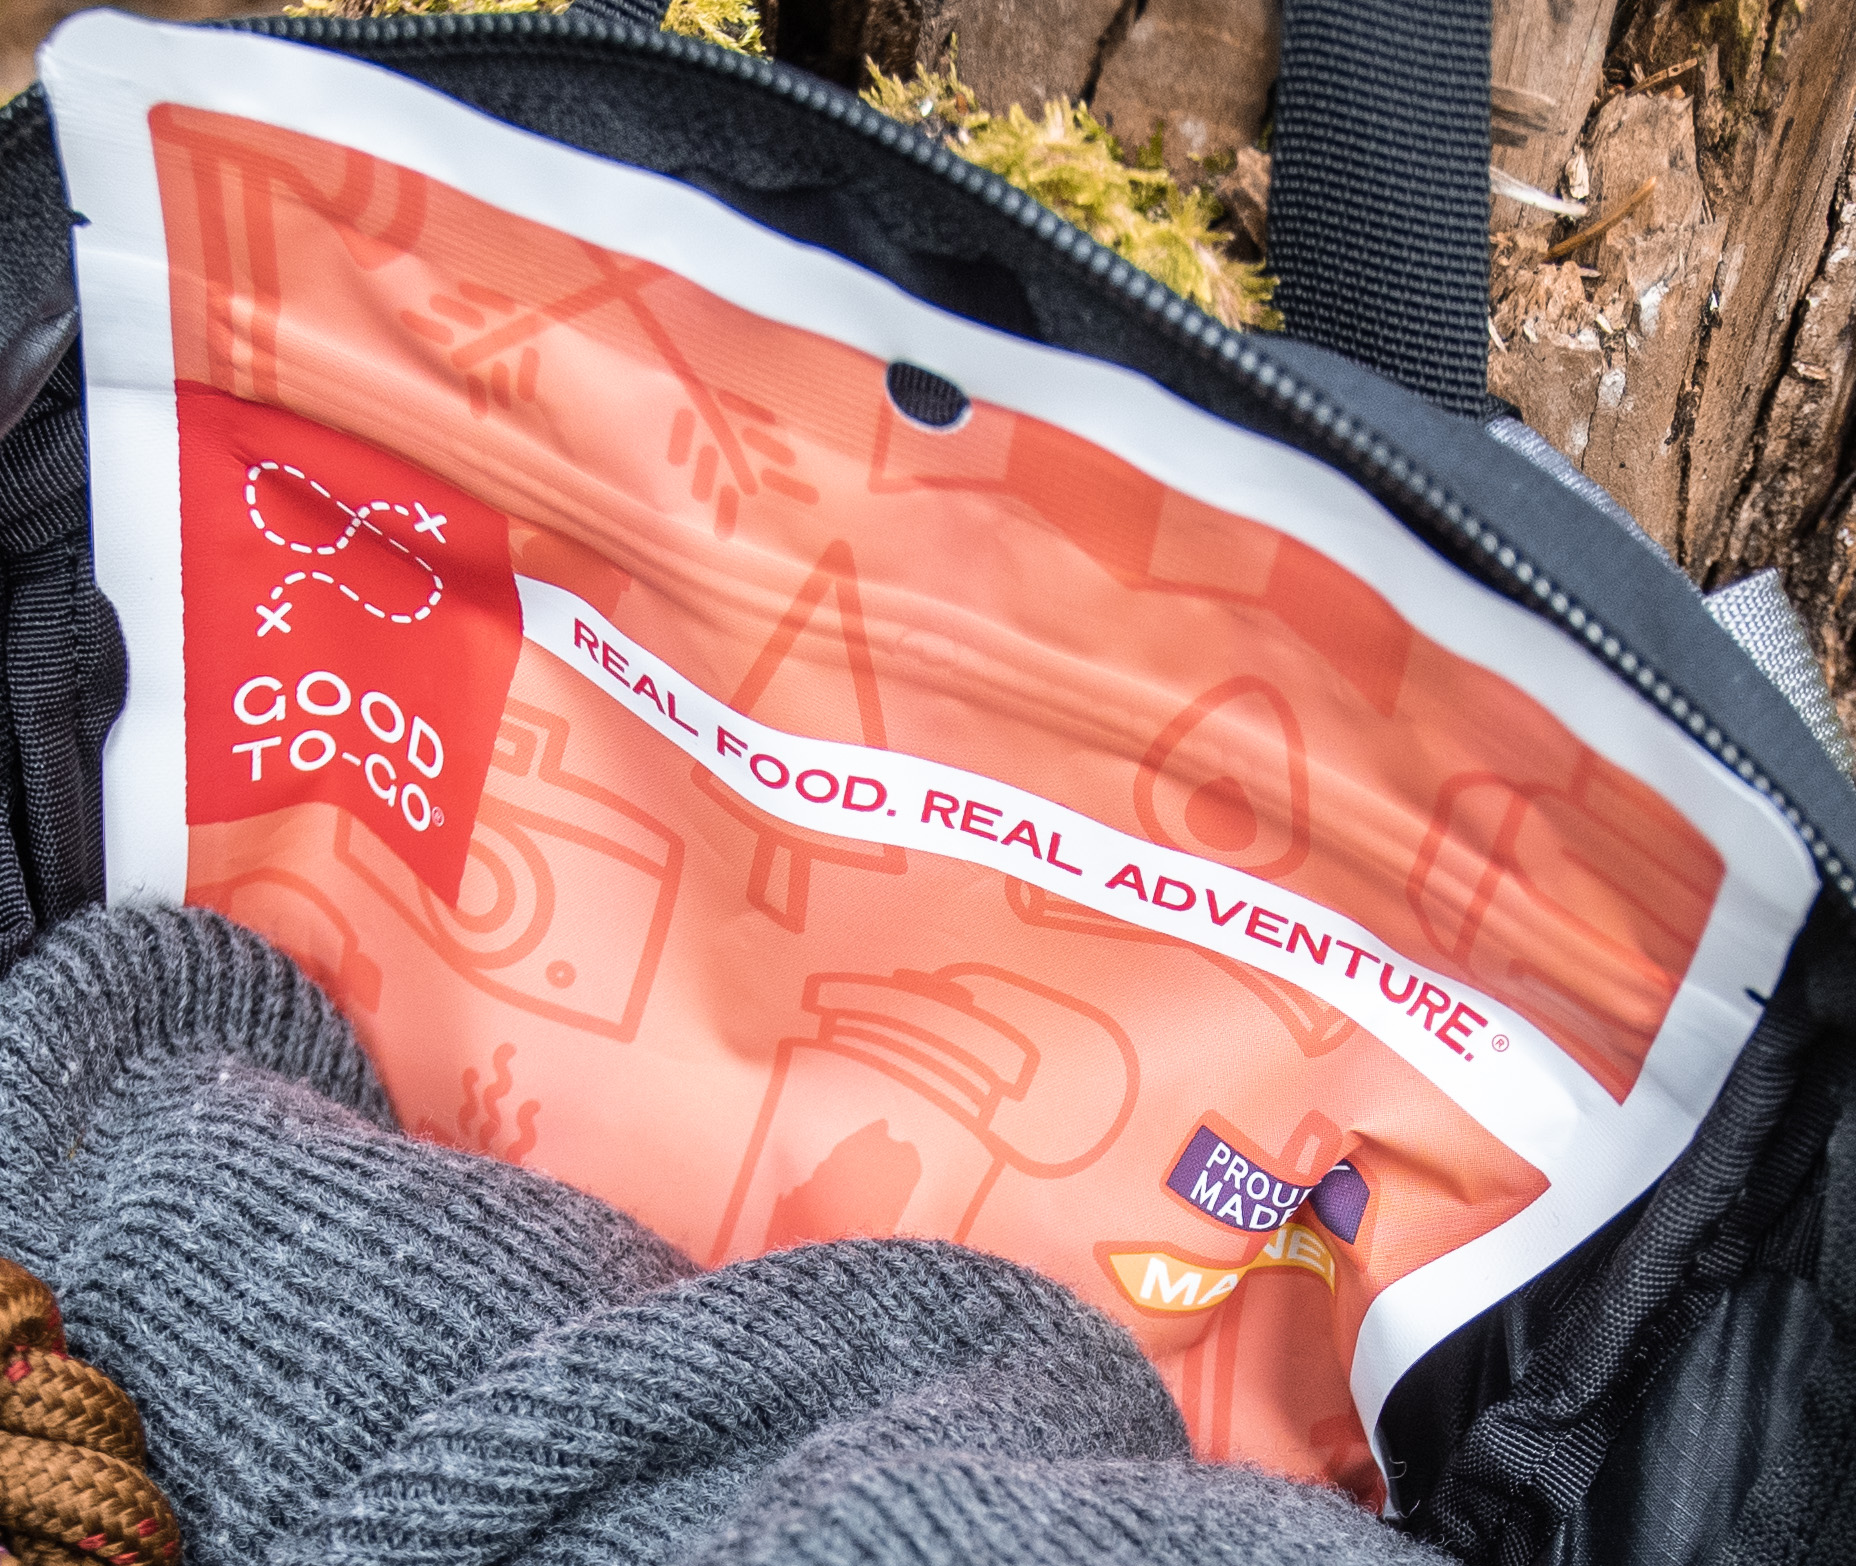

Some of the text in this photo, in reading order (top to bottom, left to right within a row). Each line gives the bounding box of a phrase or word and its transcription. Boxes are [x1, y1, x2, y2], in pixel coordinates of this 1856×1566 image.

[232, 670, 444, 779] GOOD
[573, 617, 699, 736] REAL
[716, 725, 897, 818] FOOD.
[920, 788, 1083, 877] REAL
[1205, 1141, 1350, 1208] PROU
